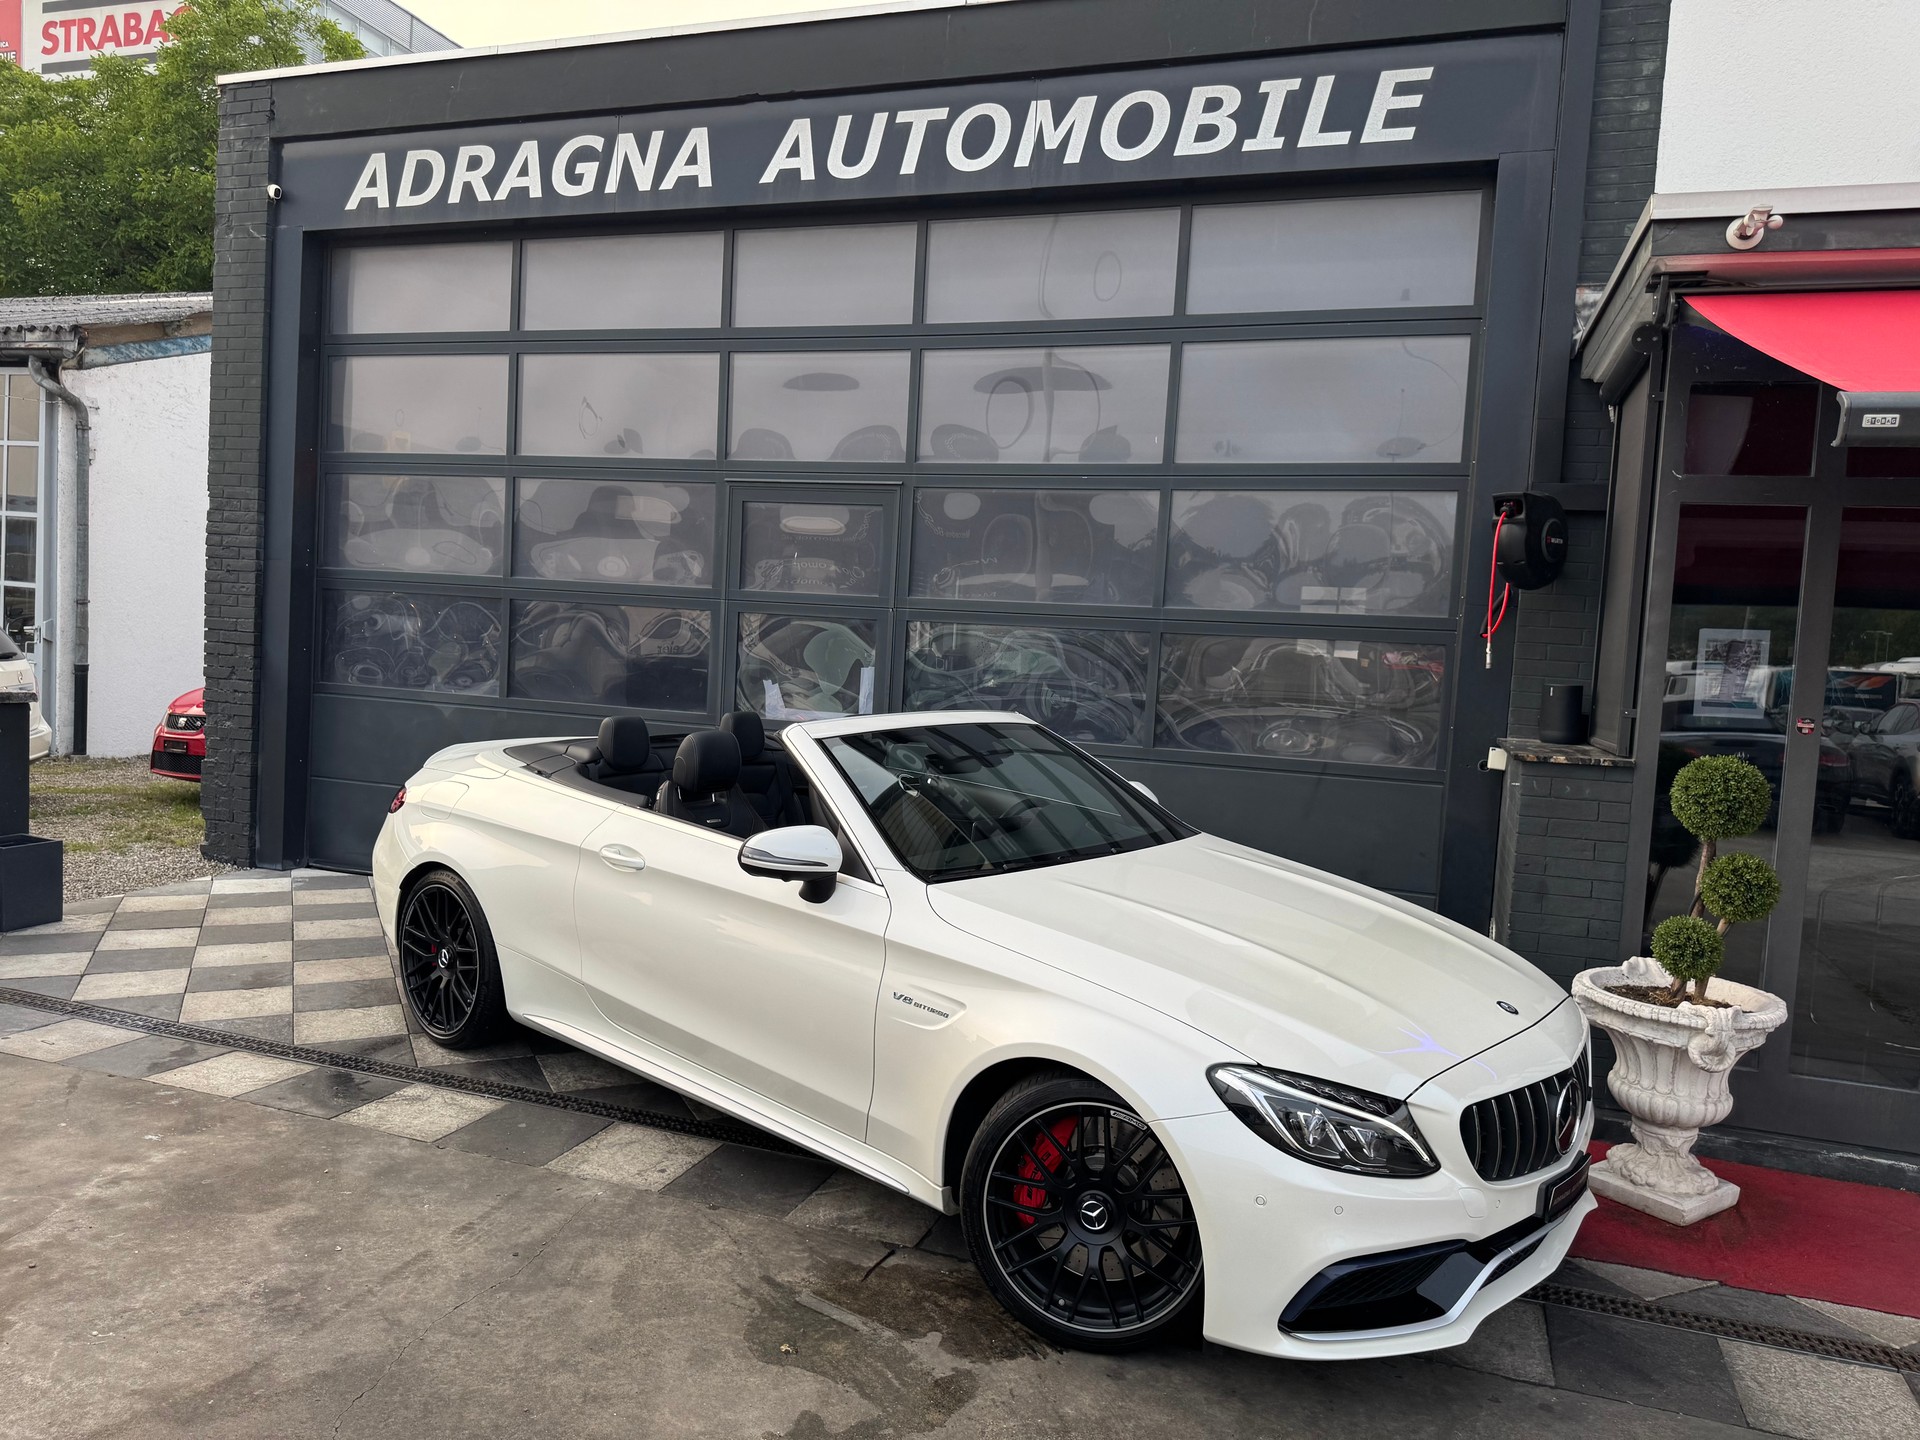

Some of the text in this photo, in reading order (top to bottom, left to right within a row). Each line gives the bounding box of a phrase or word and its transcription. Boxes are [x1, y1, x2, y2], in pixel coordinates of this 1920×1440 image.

[344, 66, 1434, 210] ADRAGNA AUTOMOBILE
[893, 991, 914, 1005] V8
